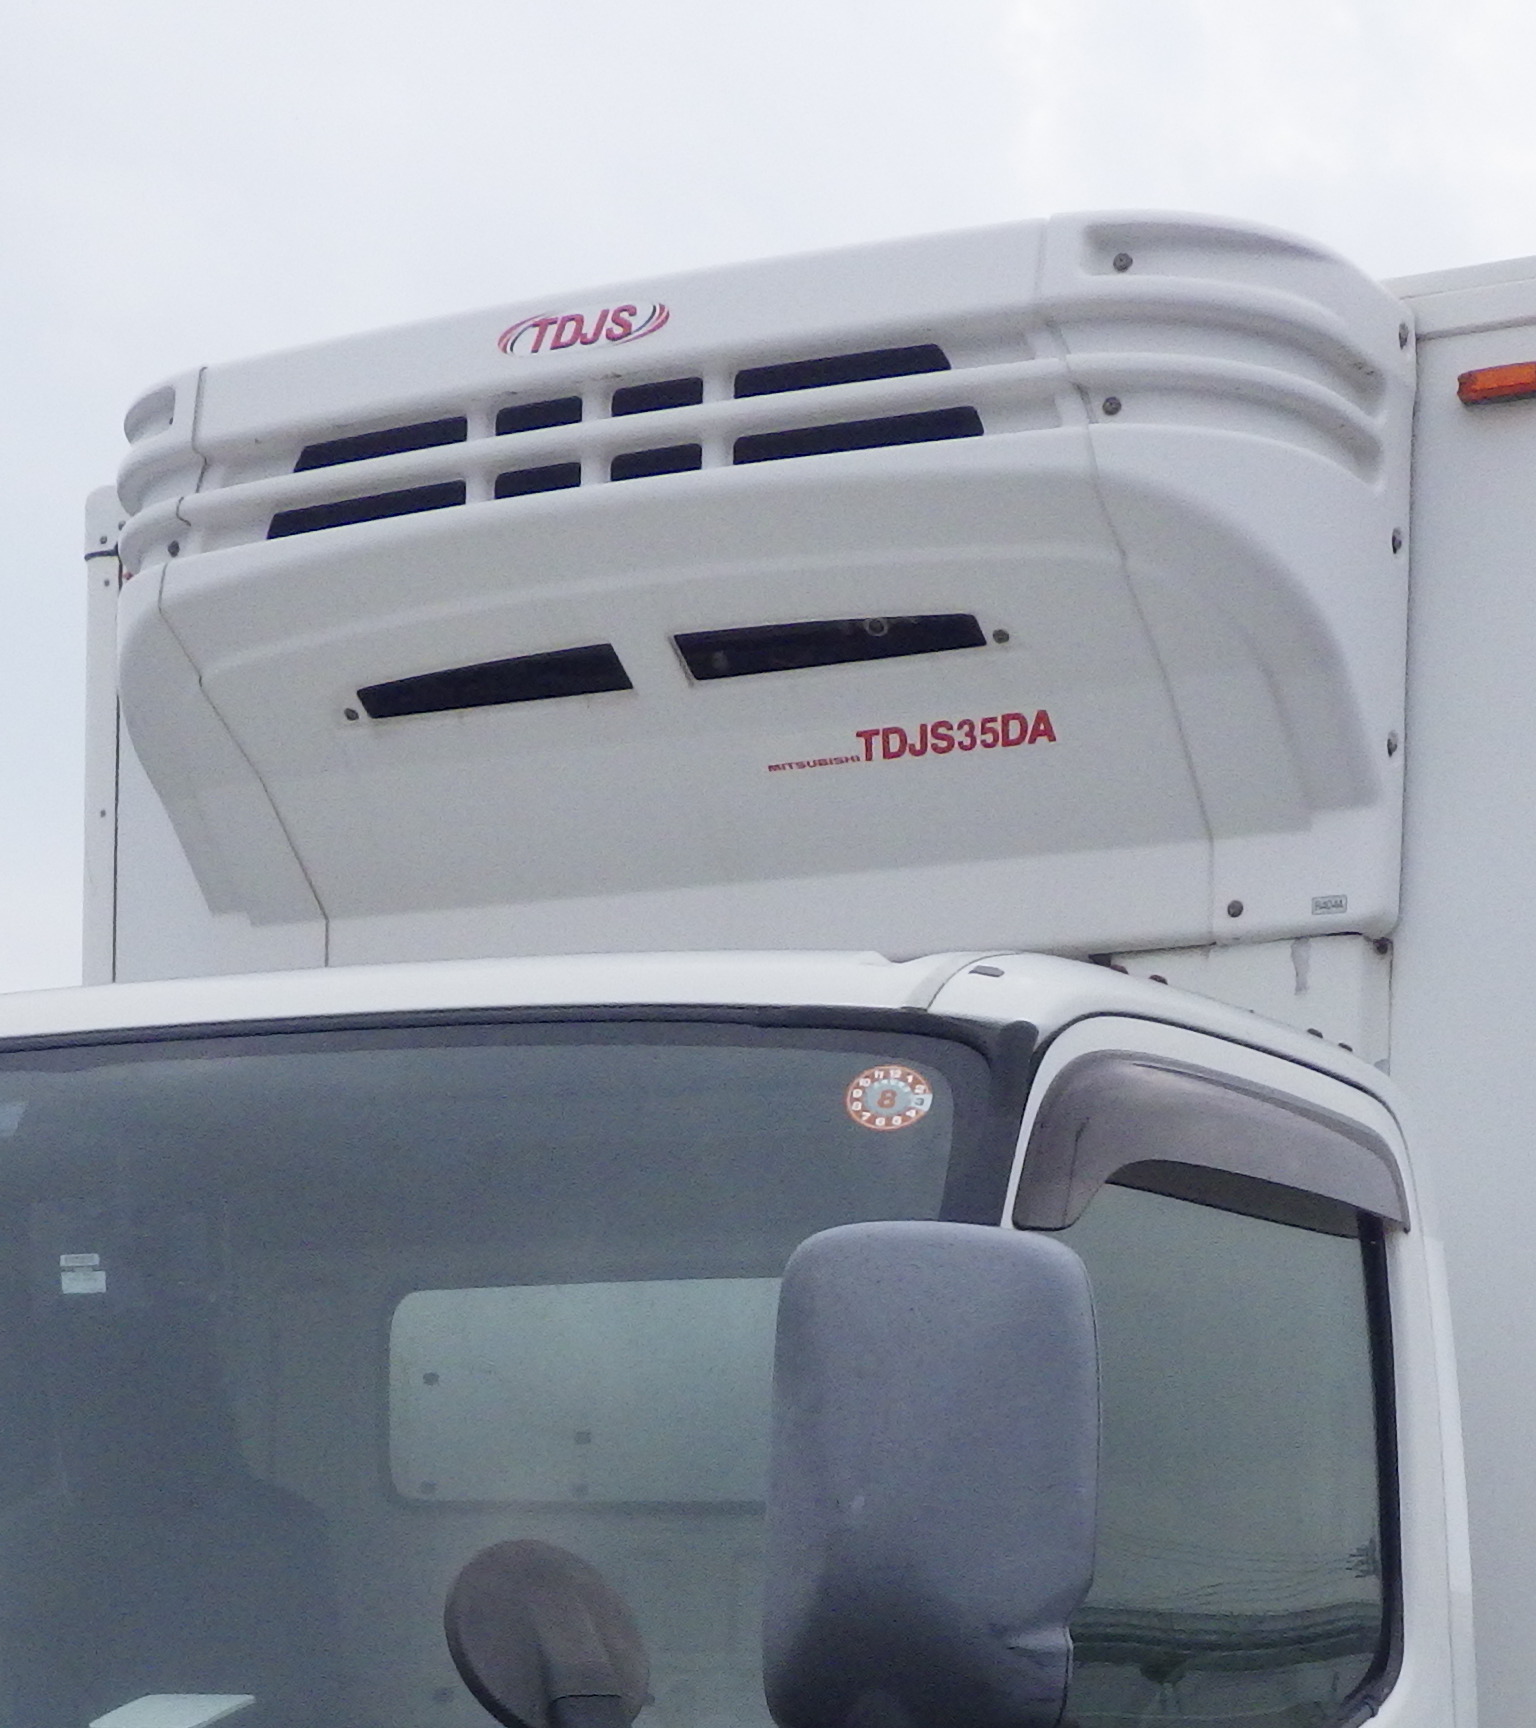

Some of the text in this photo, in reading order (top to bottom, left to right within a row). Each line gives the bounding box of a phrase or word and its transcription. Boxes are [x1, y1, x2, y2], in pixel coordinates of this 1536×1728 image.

[530, 303, 637, 354] TDJS
[767, 708, 1057, 773] MITSUBISHI TDJS35DA
[876, 1088, 898, 1110] 8
